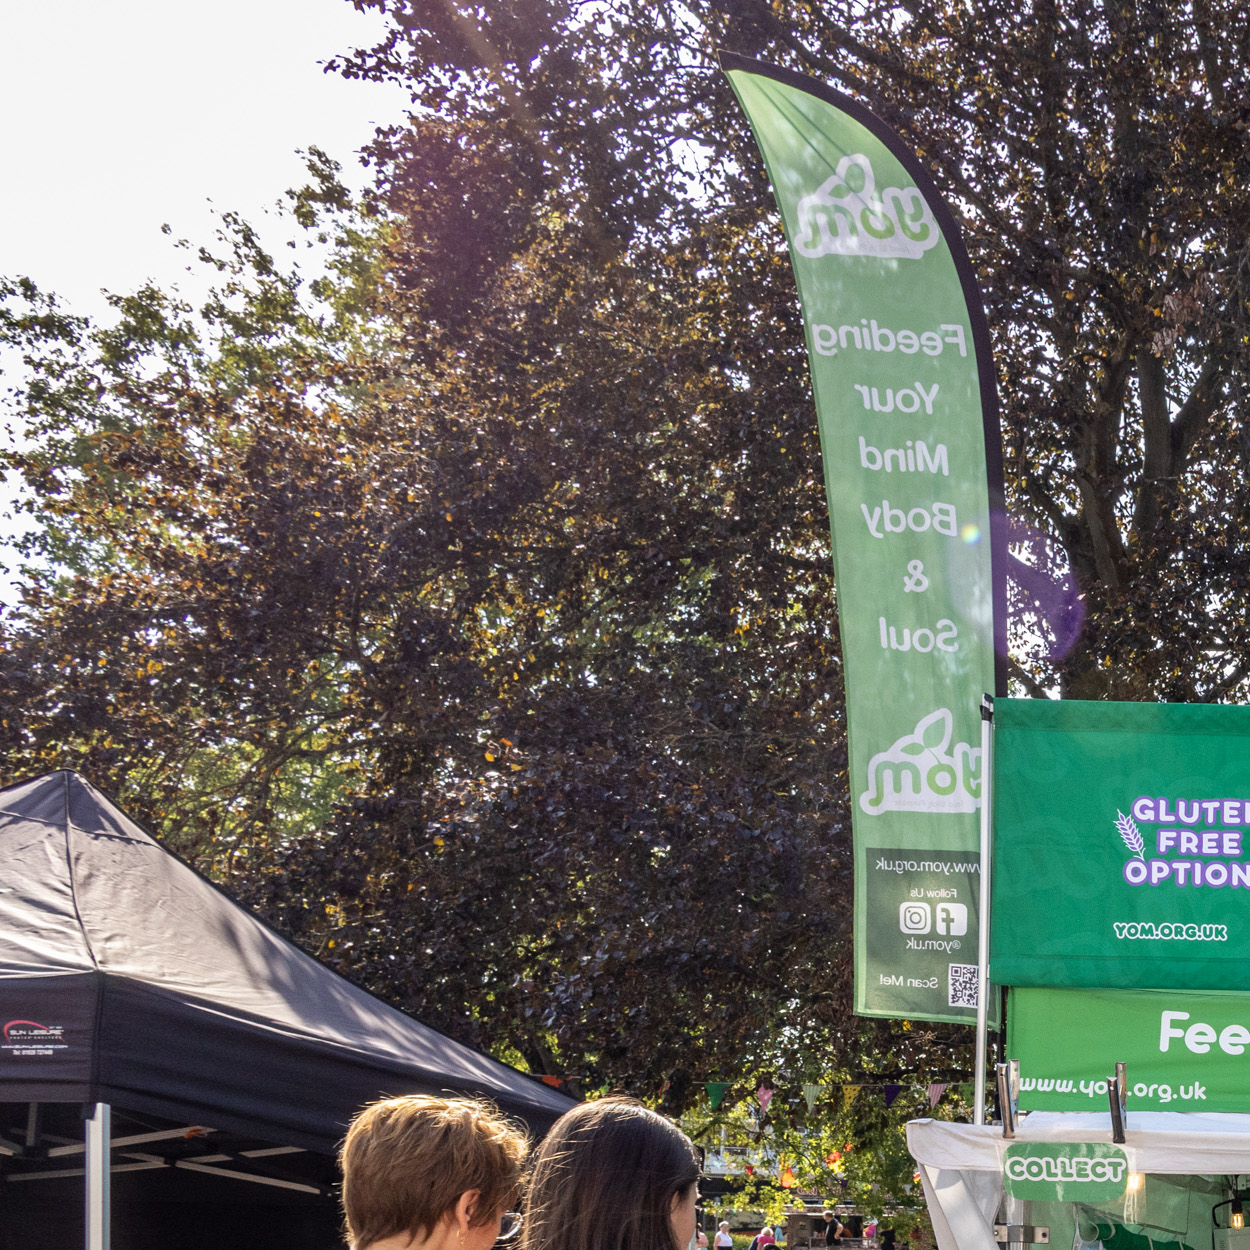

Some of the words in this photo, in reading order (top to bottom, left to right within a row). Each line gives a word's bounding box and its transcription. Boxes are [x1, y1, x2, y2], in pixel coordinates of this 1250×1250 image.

[1157, 829, 1243, 856] FREE
[1113, 922, 1227, 941] YOM.ORG.UK
[1019, 1077, 1206, 1103] www.yo.org.uk
[1005, 1157, 1126, 1182] COLLECT
